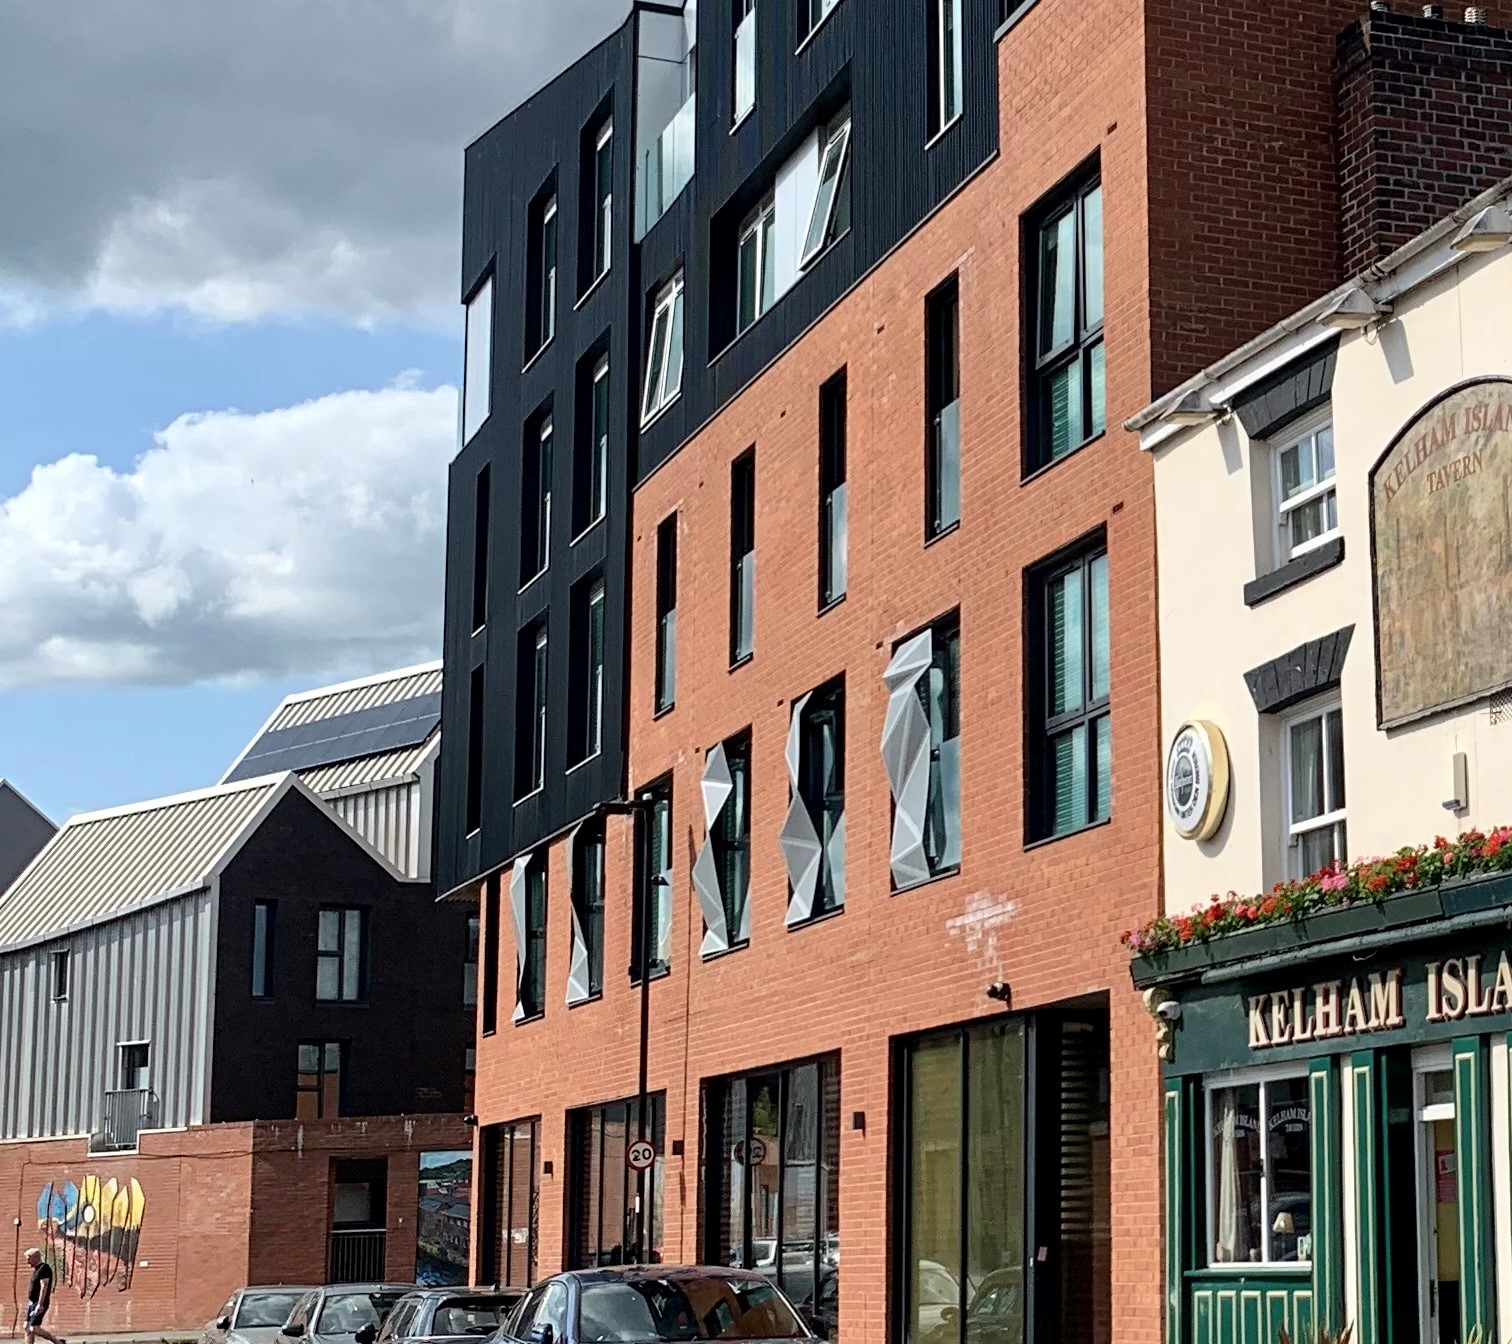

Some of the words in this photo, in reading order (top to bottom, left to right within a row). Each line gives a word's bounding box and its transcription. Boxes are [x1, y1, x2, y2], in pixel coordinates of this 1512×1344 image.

[1383, 412, 1457, 503] KELHAM
[1427, 450, 1483, 495] TAVERN
[1248, 968, 1405, 1048] KELHAM
[631, 1148, 652, 1162] 20
